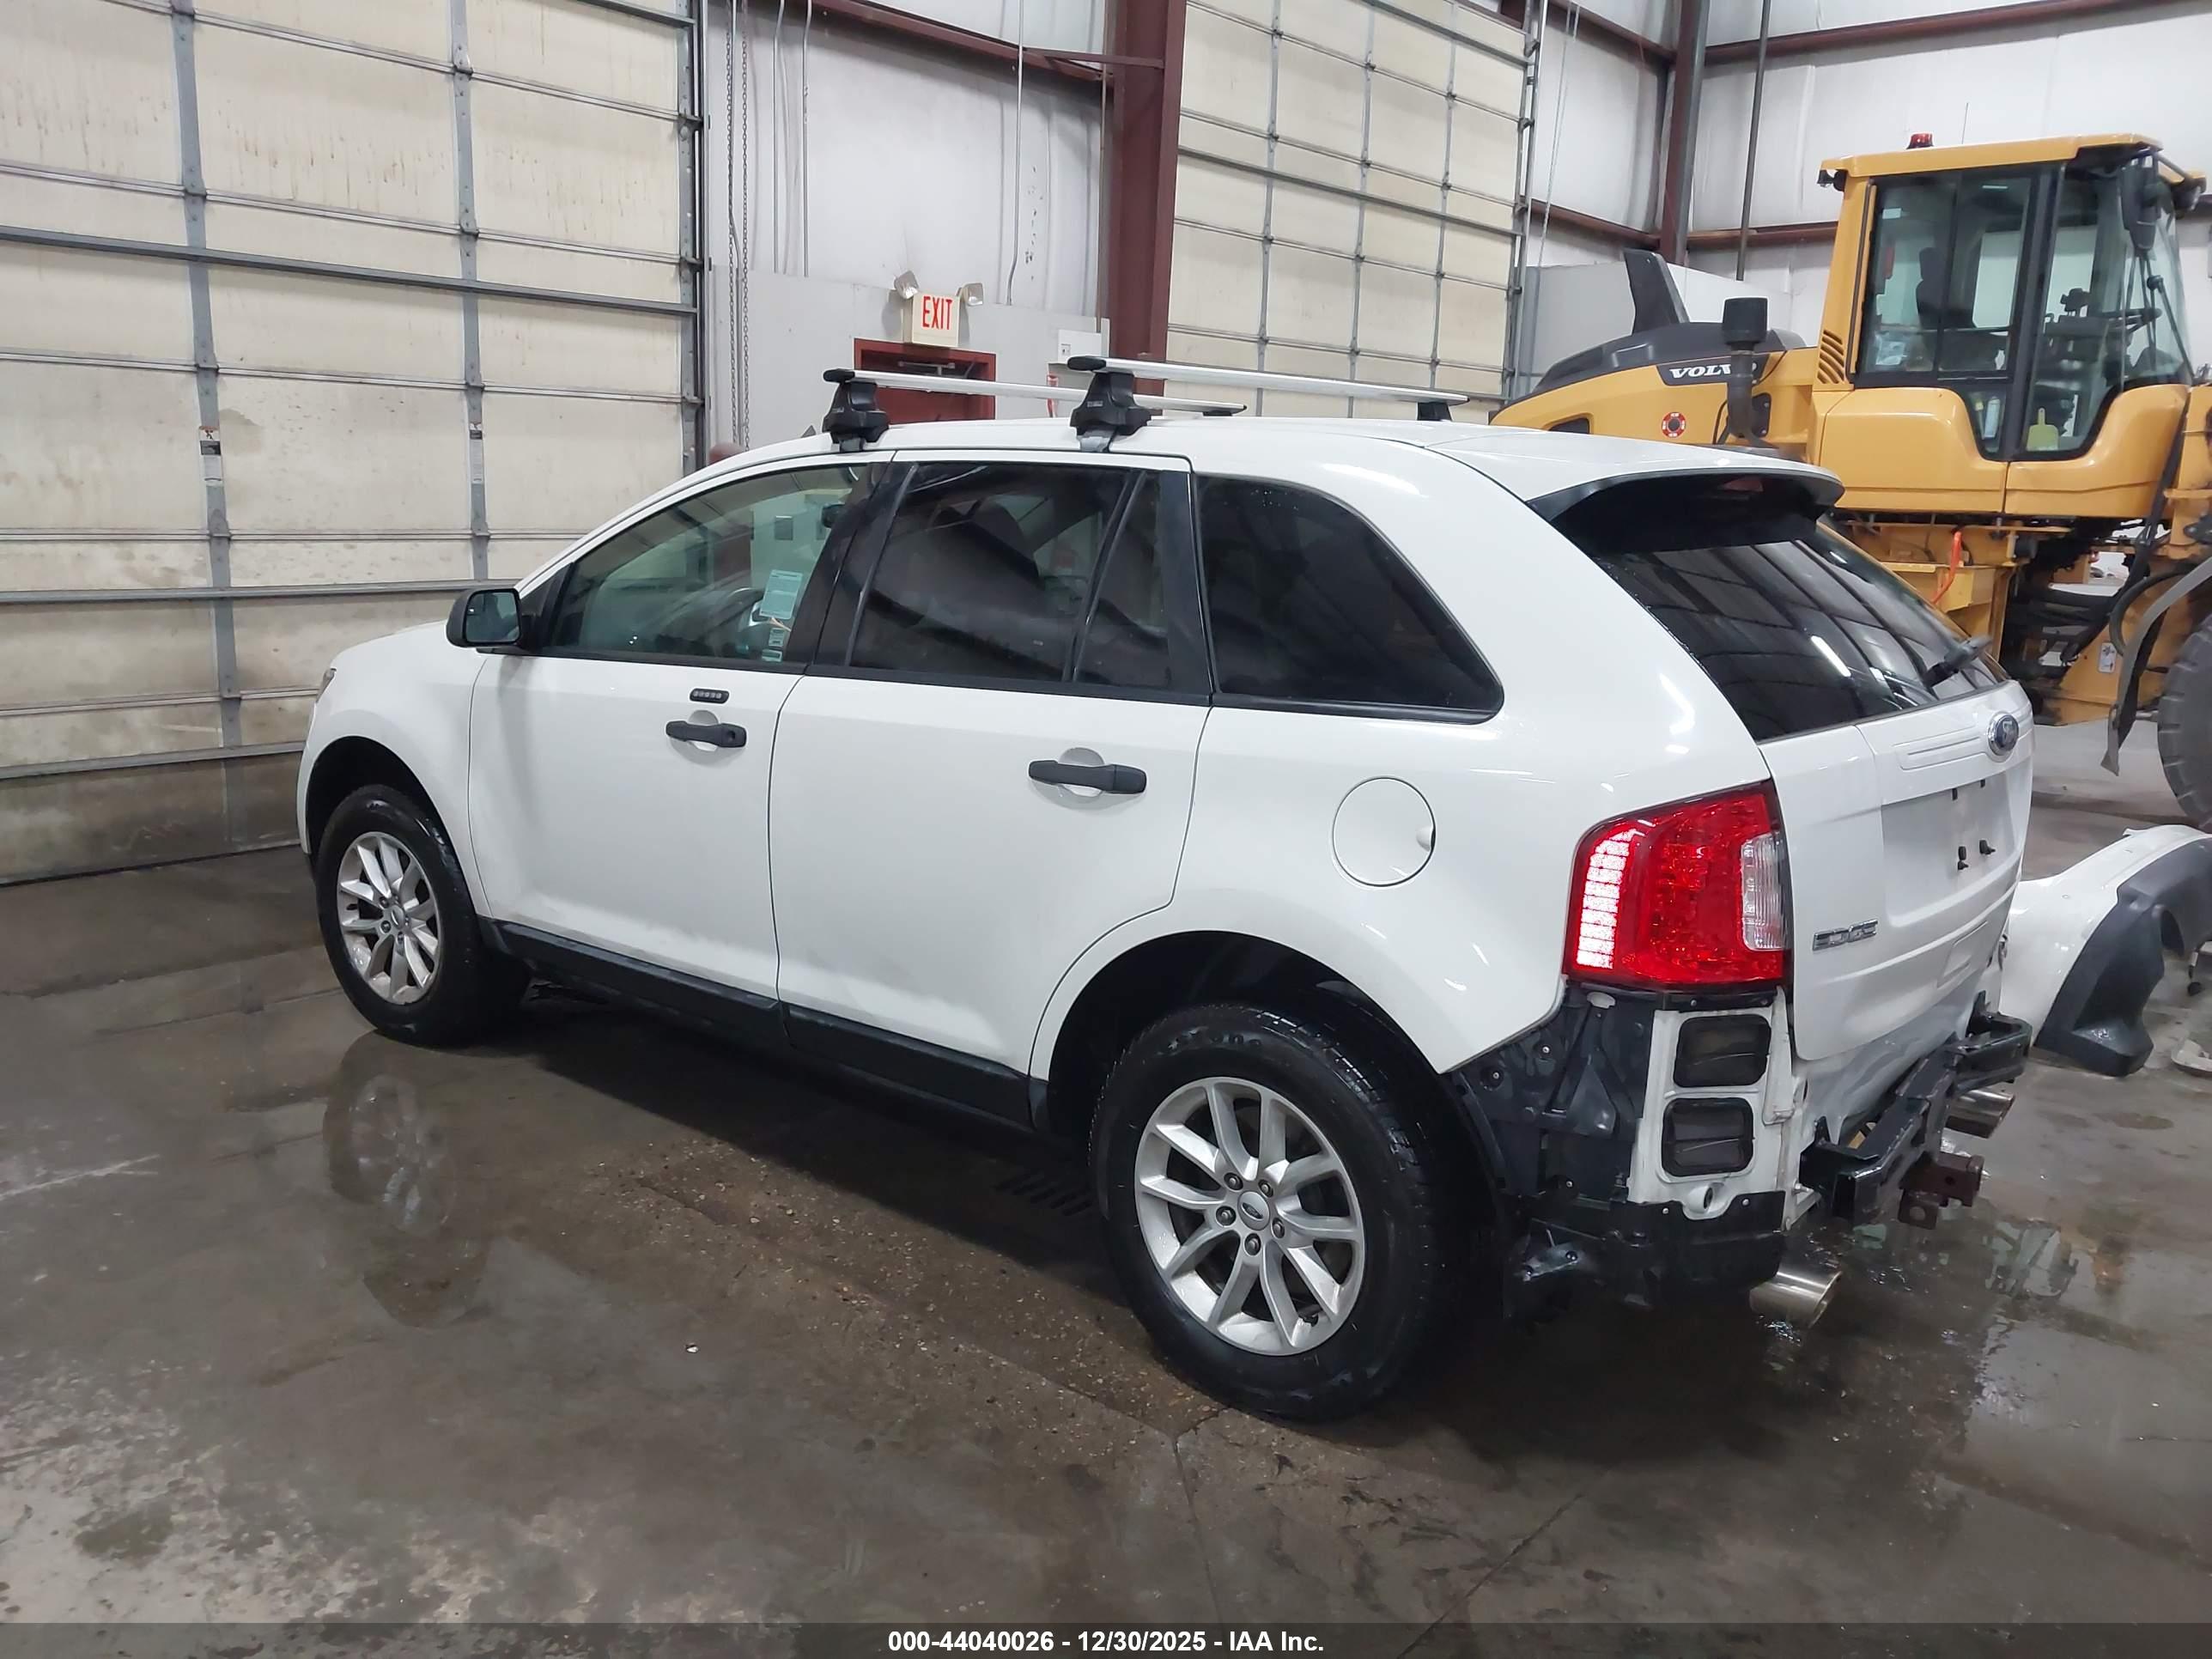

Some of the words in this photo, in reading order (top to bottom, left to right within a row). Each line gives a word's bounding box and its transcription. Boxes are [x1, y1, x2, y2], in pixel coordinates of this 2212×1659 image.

[922, 295, 953, 331] EXIT
[1669, 362, 1758, 379] VOLV
[1812, 919, 1878, 951] EDGE
